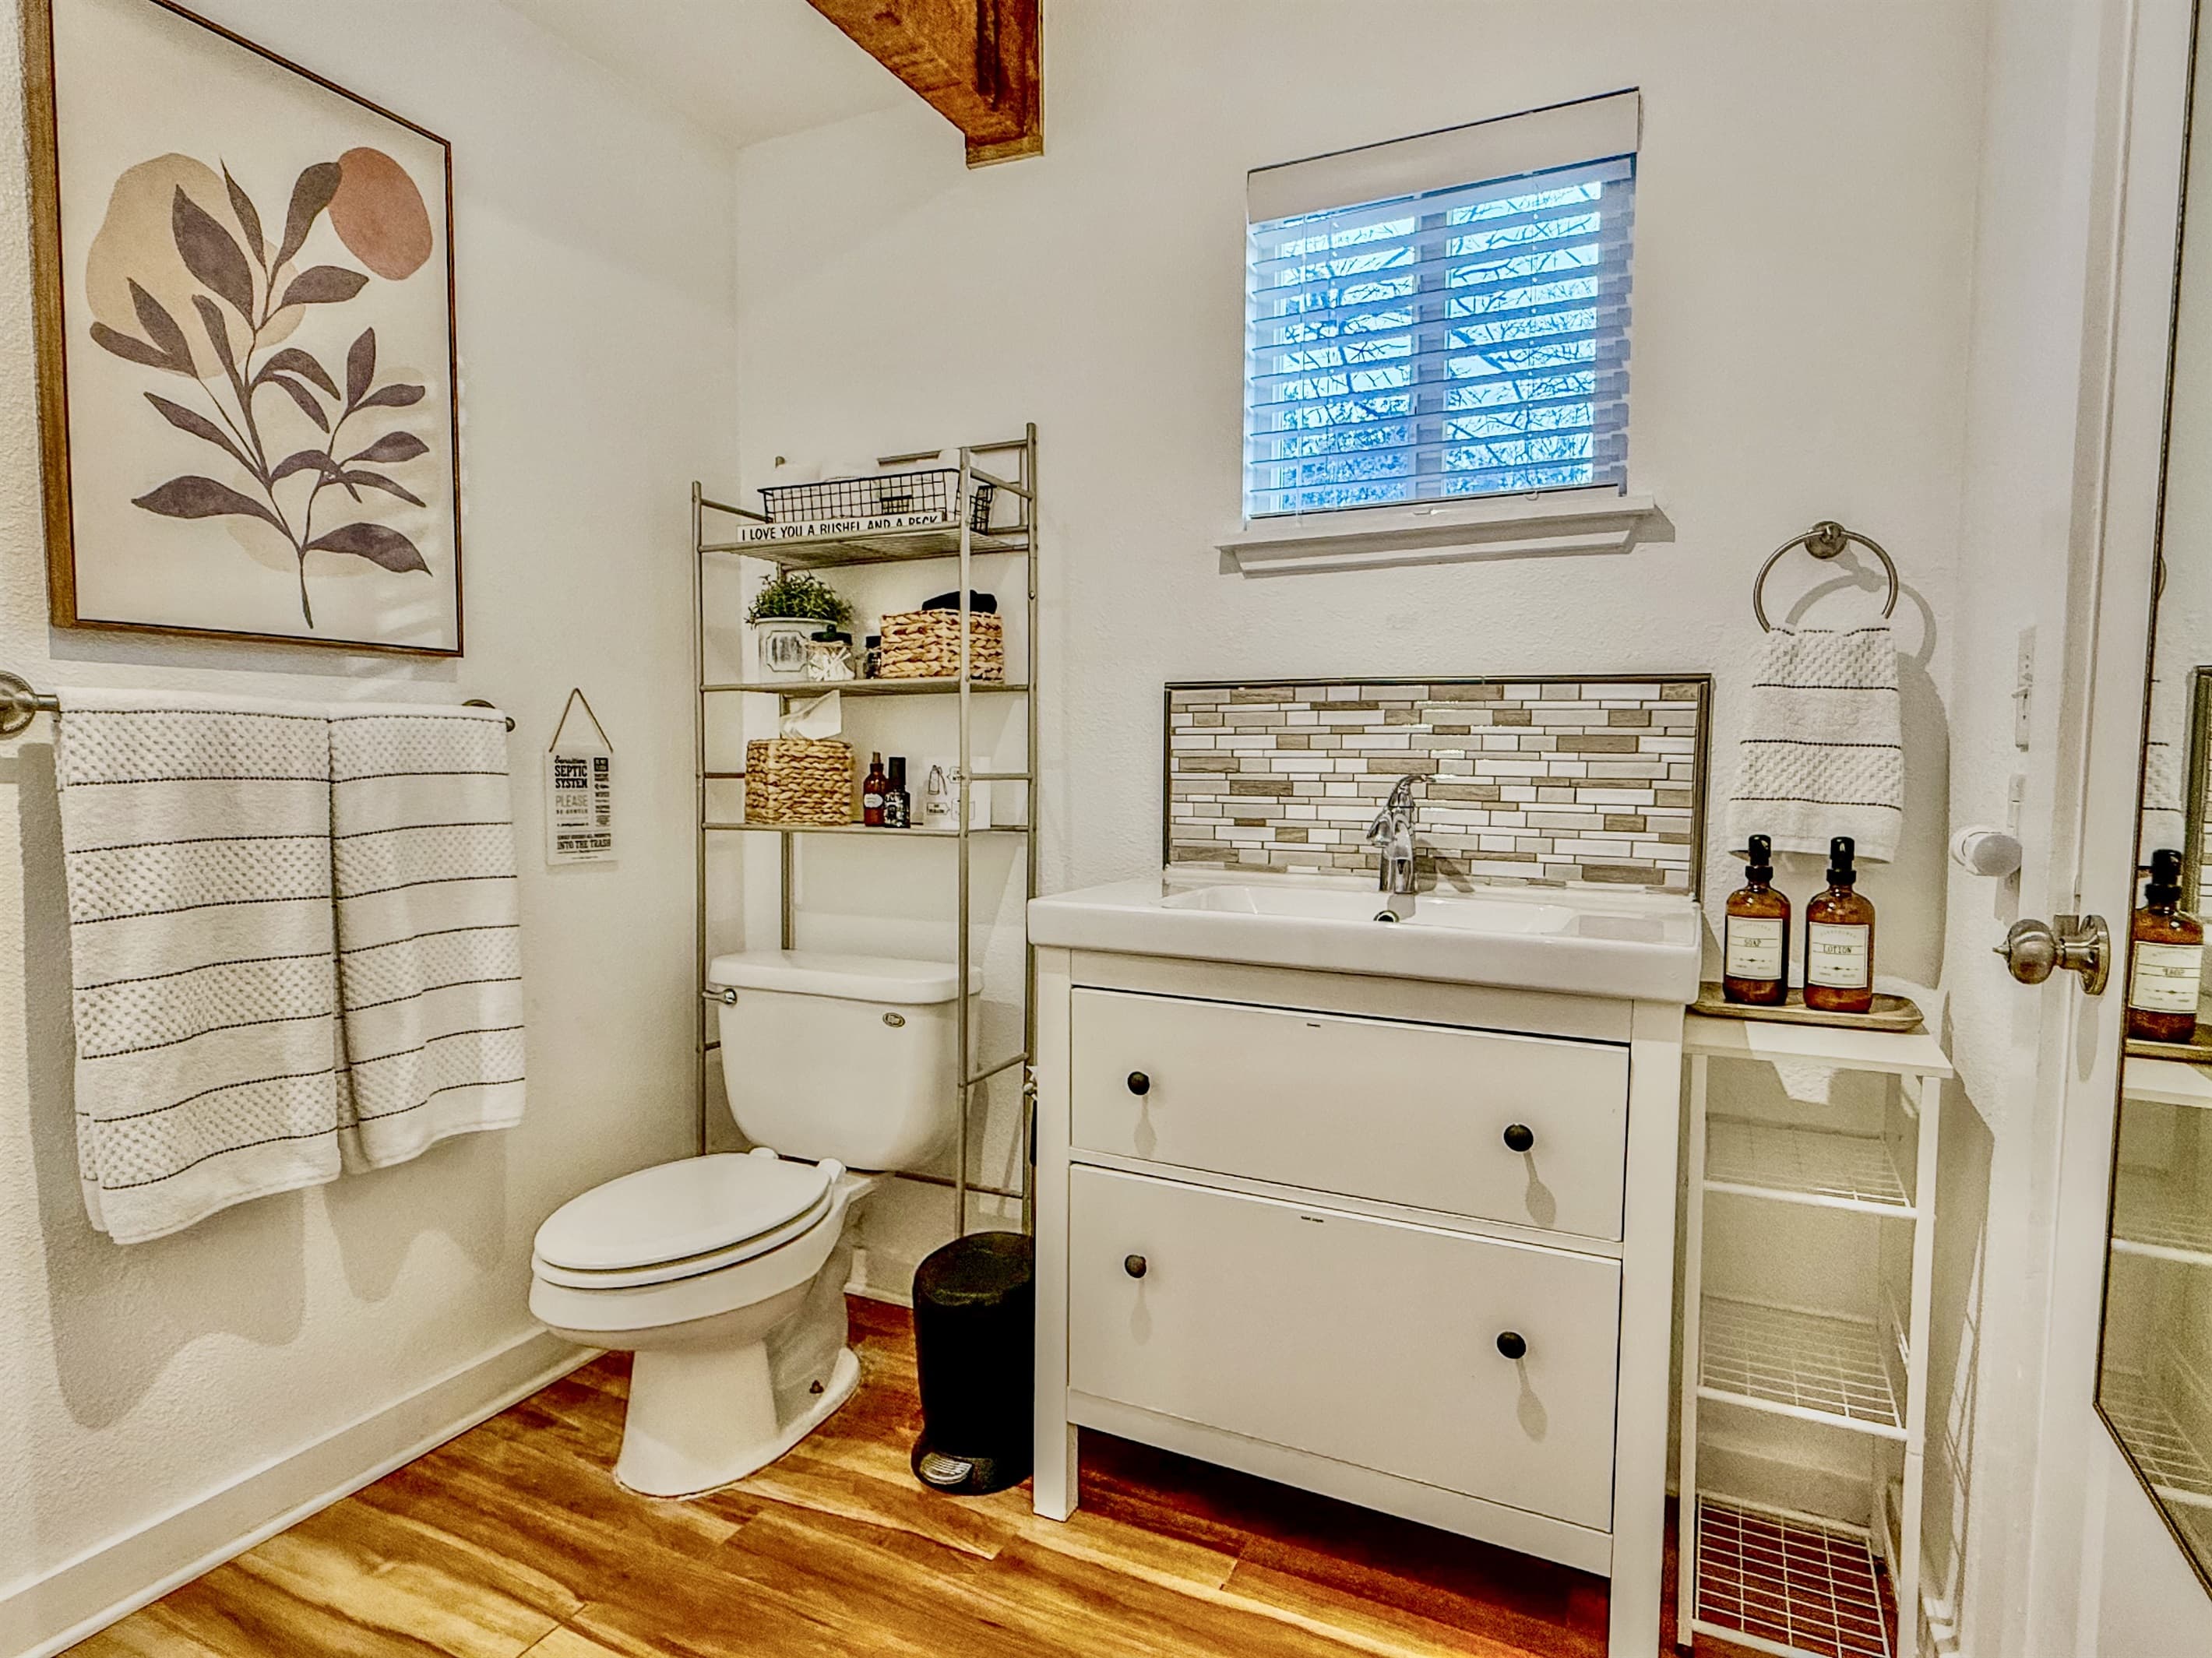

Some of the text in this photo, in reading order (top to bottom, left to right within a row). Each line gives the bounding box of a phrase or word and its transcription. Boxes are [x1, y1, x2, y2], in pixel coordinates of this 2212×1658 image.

[742, 529, 745, 540] I
[750, 527, 776, 540] LOVE
[780, 526, 802, 538] YOU
[808, 524, 815, 536] A
[868, 519, 890, 530] AND
[896, 518, 903, 526] A
[555, 765, 587, 777] SEPTIC
[555, 778, 588, 789] SYSTEM
[555, 794, 588, 808] PLEASE
[557, 839, 611, 850] INTO THE TRASH
[1823, 943, 1852, 954] LOTION
